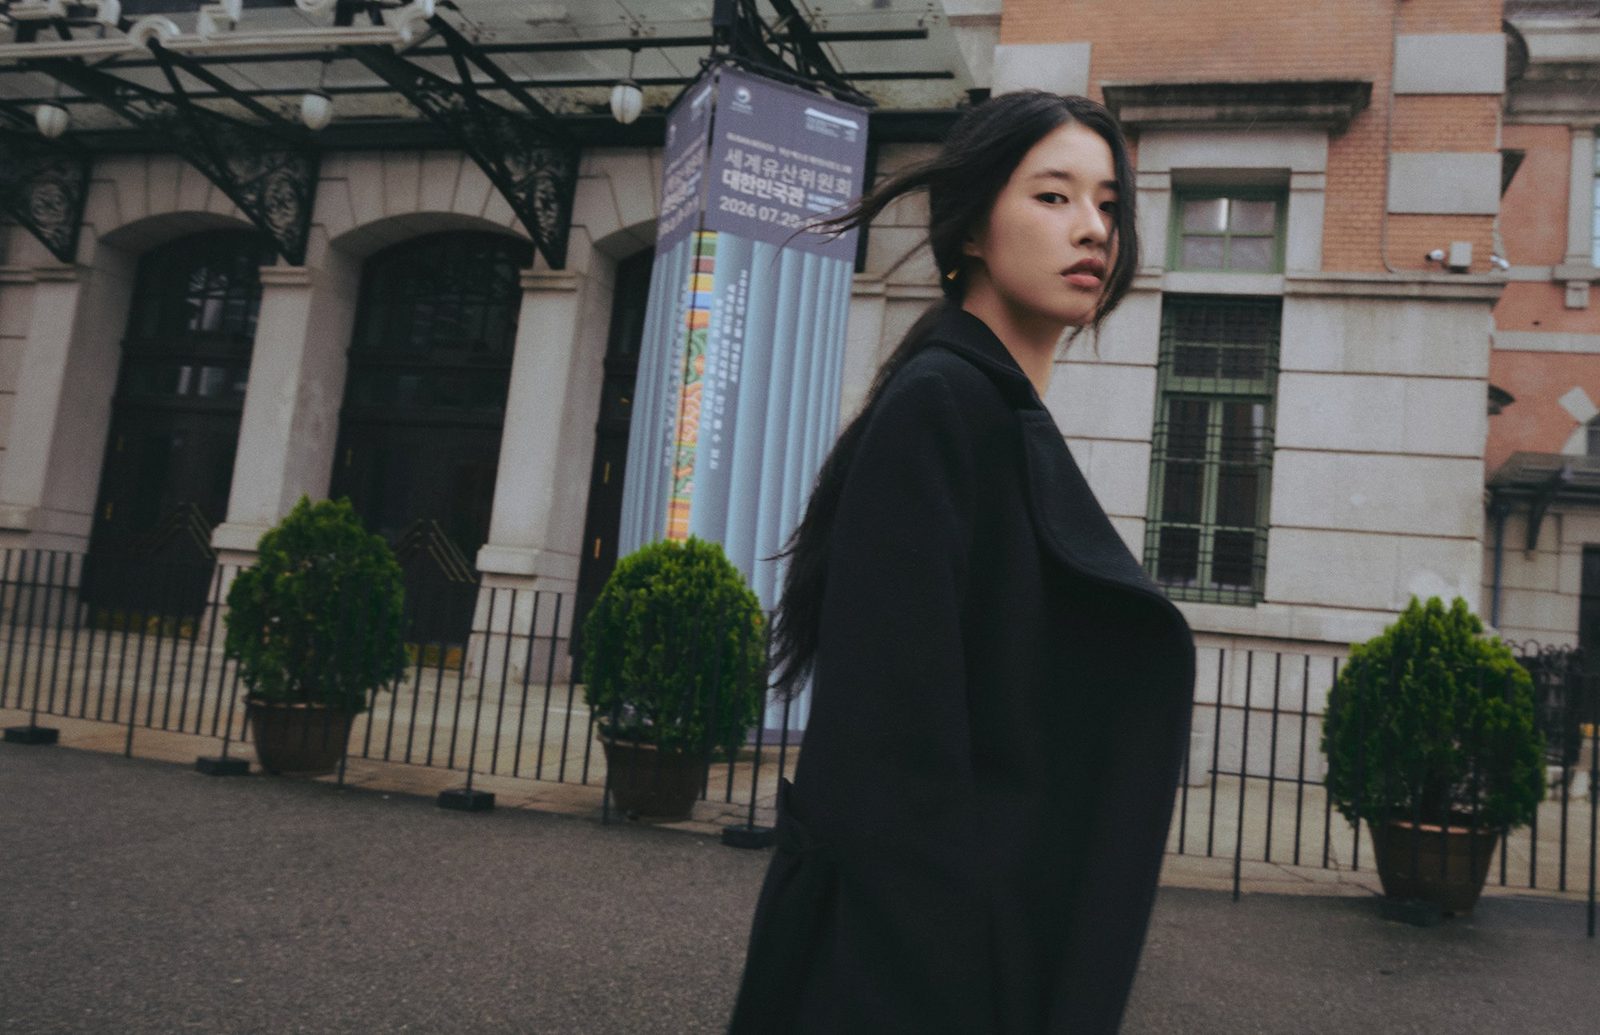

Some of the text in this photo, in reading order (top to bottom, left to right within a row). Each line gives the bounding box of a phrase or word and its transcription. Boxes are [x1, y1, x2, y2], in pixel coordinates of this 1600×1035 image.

[721, 168, 805, 209] 대한민국관
[724, 148, 852, 199] 세계유산위원회
[719, 195, 757, 219] 2026
